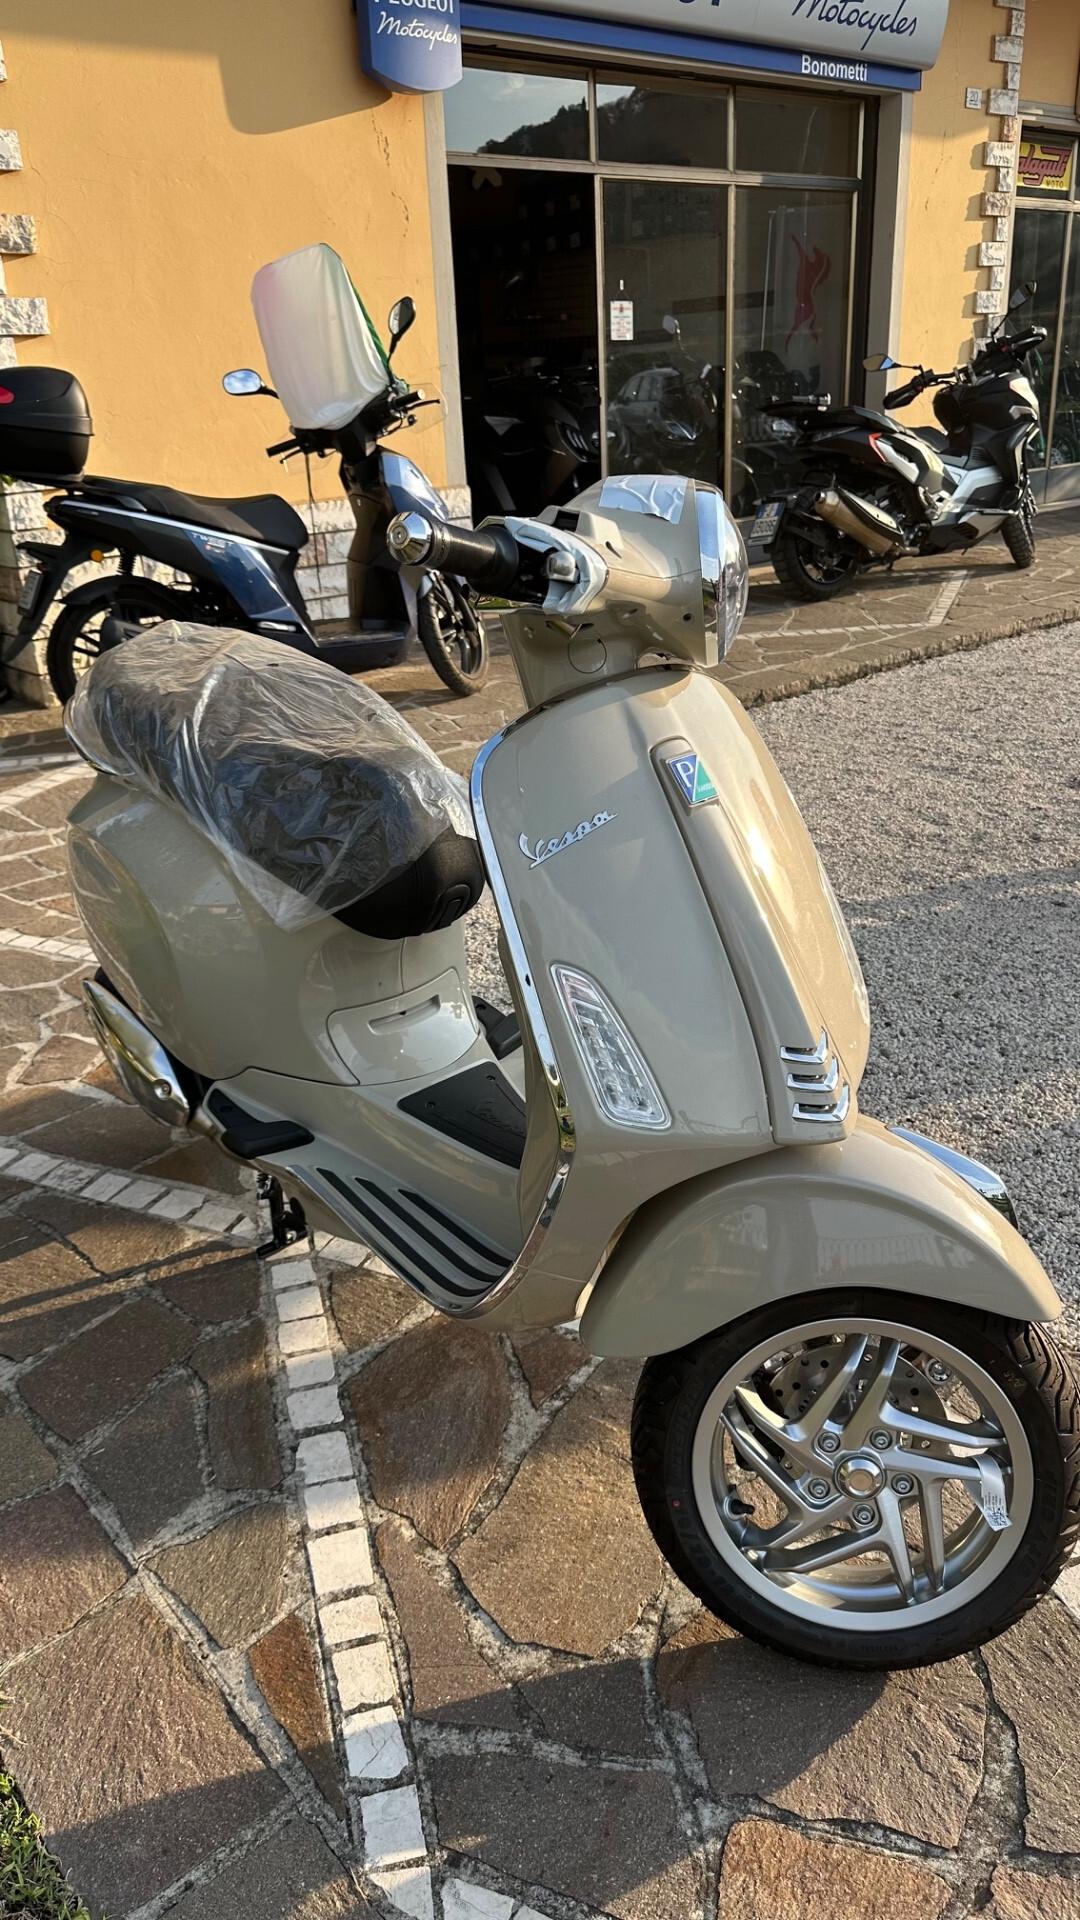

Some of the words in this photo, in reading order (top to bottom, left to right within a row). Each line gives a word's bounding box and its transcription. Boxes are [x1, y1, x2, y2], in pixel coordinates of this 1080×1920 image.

[374, 0, 454, 14] GEOT
[376, 11, 458, 51] Motocycles
[801, 54, 868, 82] Bonometti
[675, 761, 695, 788] P
[518, 809, 619, 870] Vespa
